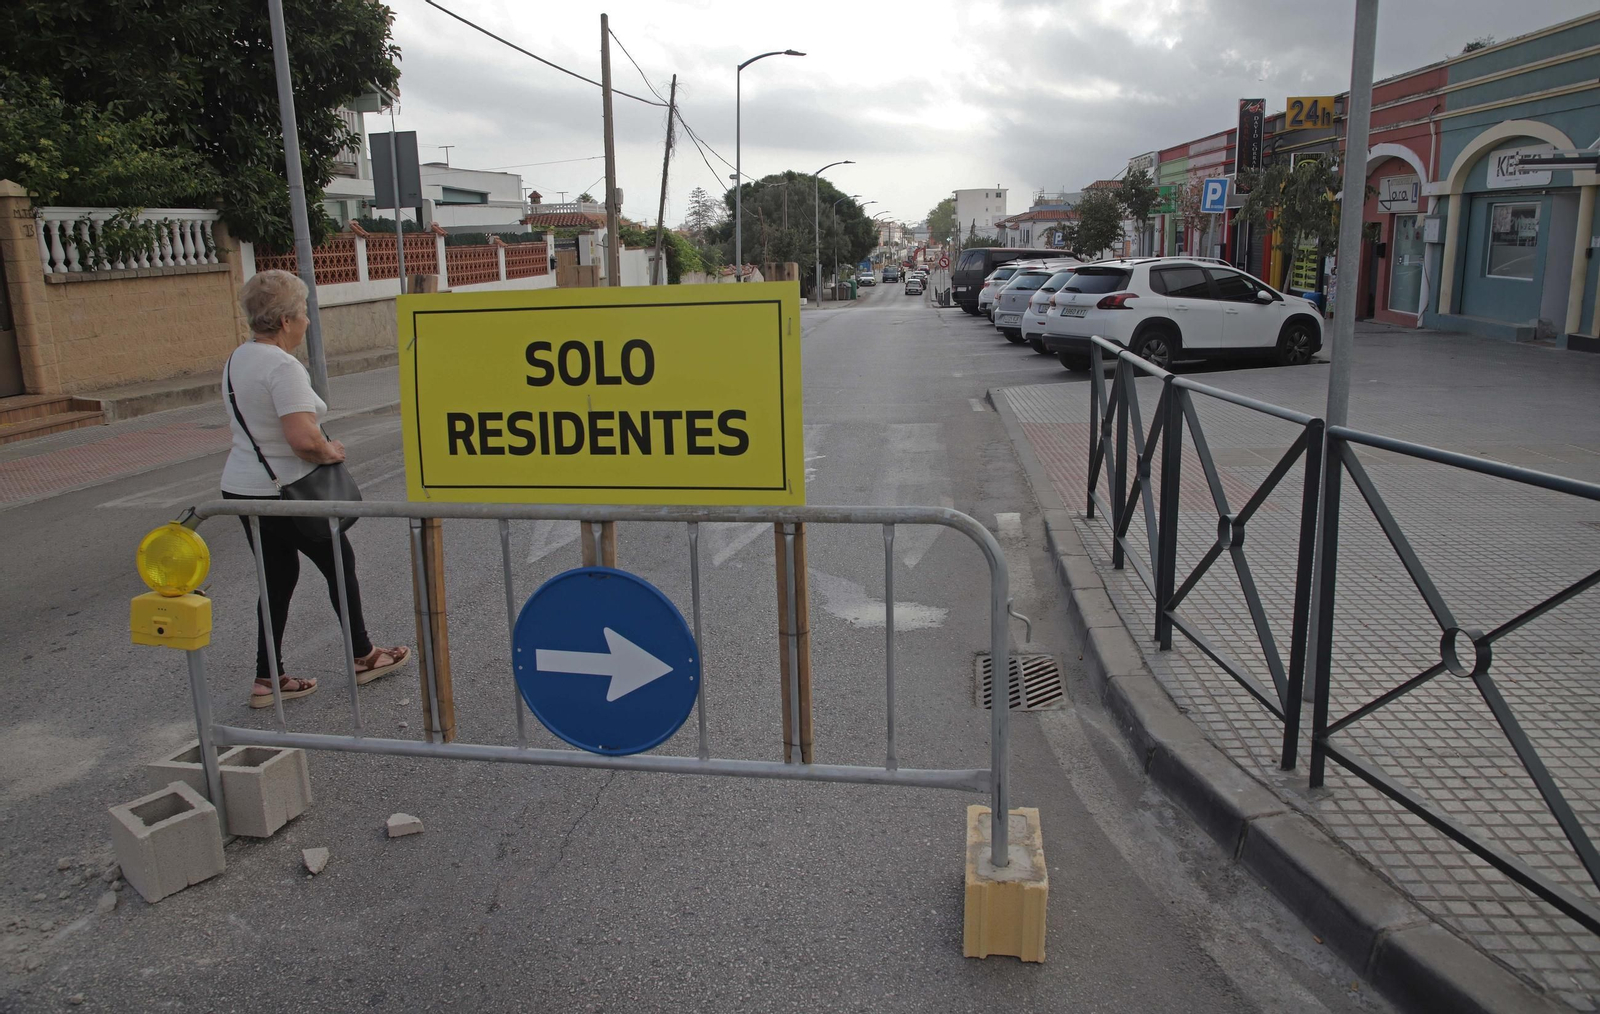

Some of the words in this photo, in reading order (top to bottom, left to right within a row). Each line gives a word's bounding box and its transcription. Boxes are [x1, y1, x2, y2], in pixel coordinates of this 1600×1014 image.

[1290, 99, 1331, 127] 24h
[1205, 182, 1222, 209] P
[525, 338, 655, 387] SOLO
[446, 409, 750, 456] RESIDENTES
